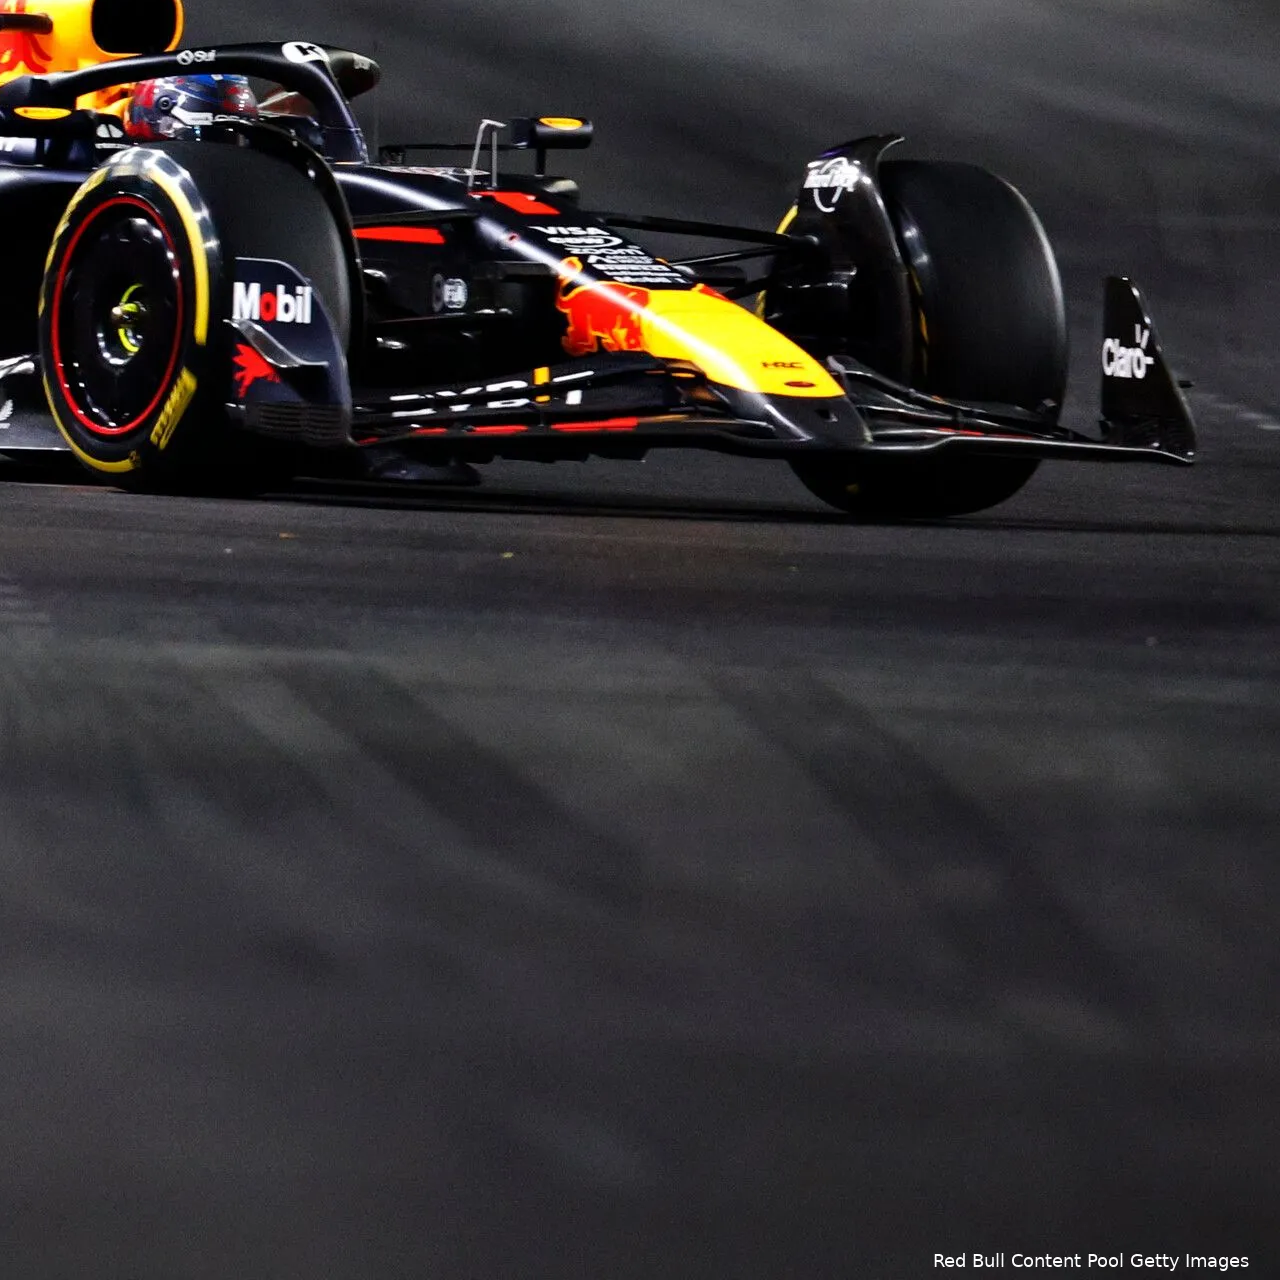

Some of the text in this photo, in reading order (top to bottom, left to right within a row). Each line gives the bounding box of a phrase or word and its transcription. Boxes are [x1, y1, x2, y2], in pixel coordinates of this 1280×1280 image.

[528, 226, 611, 236] VISA
[232, 281, 313, 324] Mobil
[1102, 338, 1146, 379] Claro
